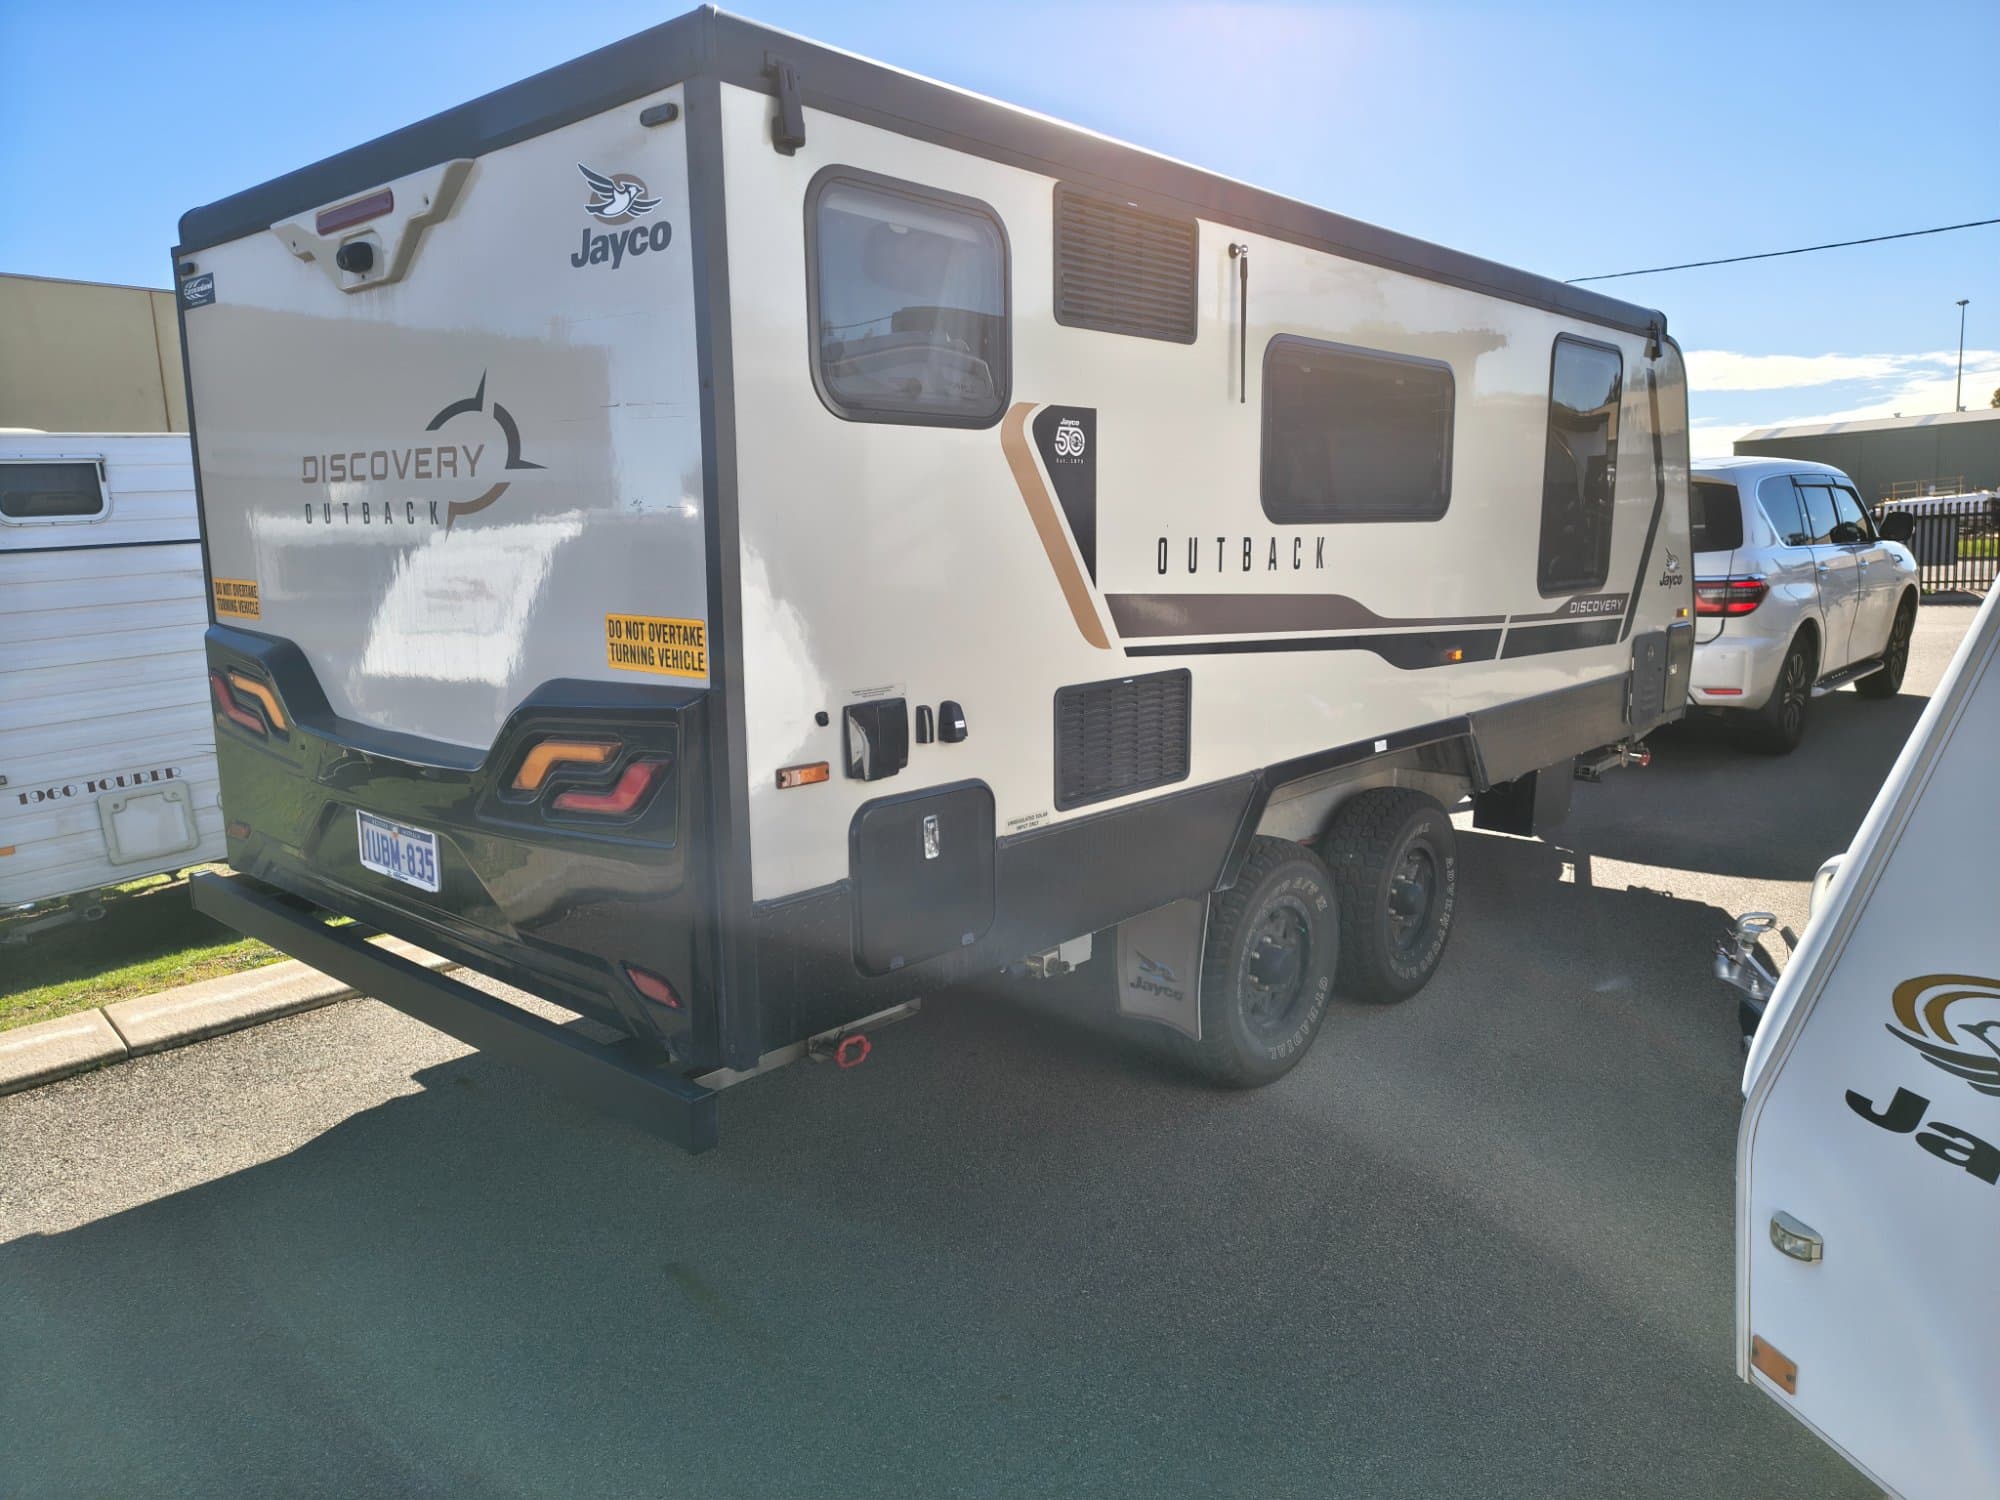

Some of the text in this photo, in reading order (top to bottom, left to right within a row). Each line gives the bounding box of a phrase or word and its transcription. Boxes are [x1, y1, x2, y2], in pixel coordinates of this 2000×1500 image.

[571, 221, 673, 270] Jayco
[1060, 418, 1080, 427] Jayco
[302, 444, 485, 484] DISCOVERY
[305, 501, 439, 525] OUTBACK
[1157, 536, 1325, 575] OUTBACK
[215, 581, 257, 599] DO NOT OVERTAKE
[1659, 571, 1683, 589] Jayco
[216, 598, 259, 616] TURNING VEHICLE
[1569, 600, 1623, 614] DISCOVERY
[608, 619, 704, 648] DO NOT OVERTAKE
[609, 642, 705, 673] TURNING VEHICLE
[18, 766, 182, 805] 1960 TOURER
[1129, 975, 1185, 1001] Jayco
